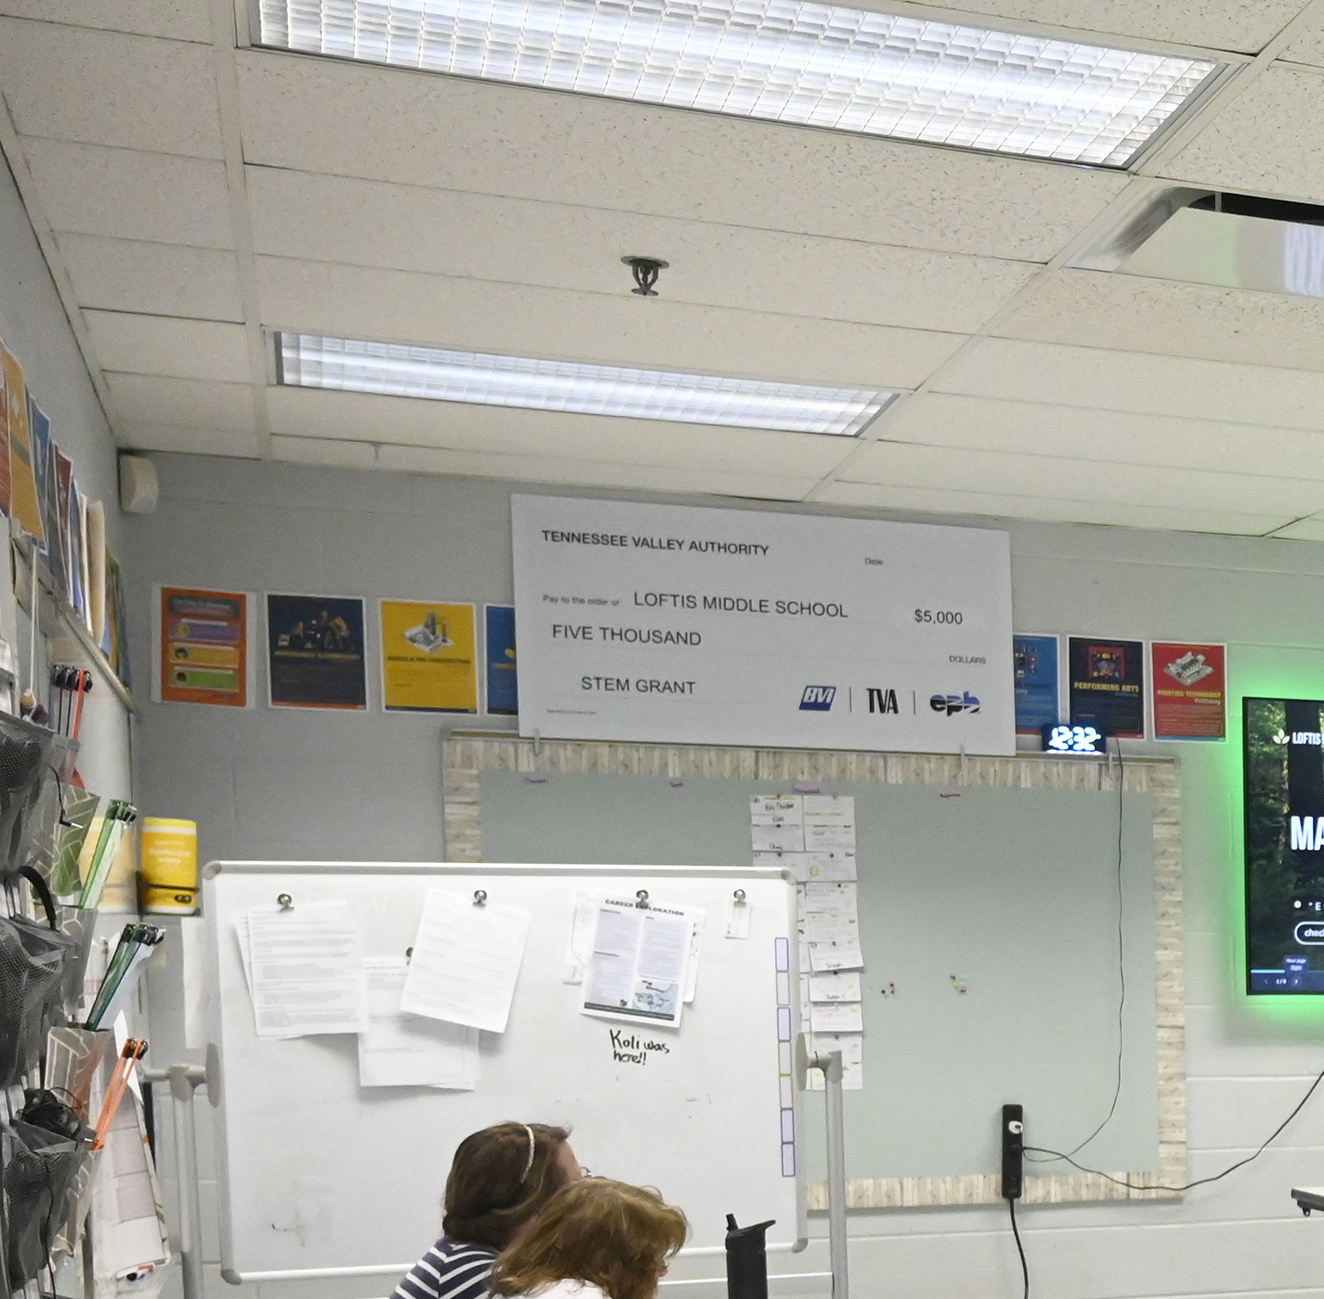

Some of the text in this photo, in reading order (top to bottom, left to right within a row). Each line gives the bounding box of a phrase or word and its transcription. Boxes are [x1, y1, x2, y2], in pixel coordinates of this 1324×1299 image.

[542, 530, 769, 556] TENNESSEE VALLEY AUTHORITY
[634, 592, 848, 618] LOFTIS MIDDLE SCHOOL
[914, 609, 963, 625] $5,000
[552, 624, 701, 646] FIVE THOUSAND
[949, 655, 986, 664] DOLLARS
[581, 676, 696, 694] STEM GRANT
[1074, 682, 1140, 693] PERFORMING ARTS
[866, 688, 899, 715] TVA
[929, 691, 981, 716] epb
[1048, 726, 1102, 751] 12:32
[1292, 731, 1322, 745] LOFTIS
[605, 899, 685, 916] CAREER LORATION
[643, 1040, 670, 1054] was
[613, 1049, 647, 1066] here!!
